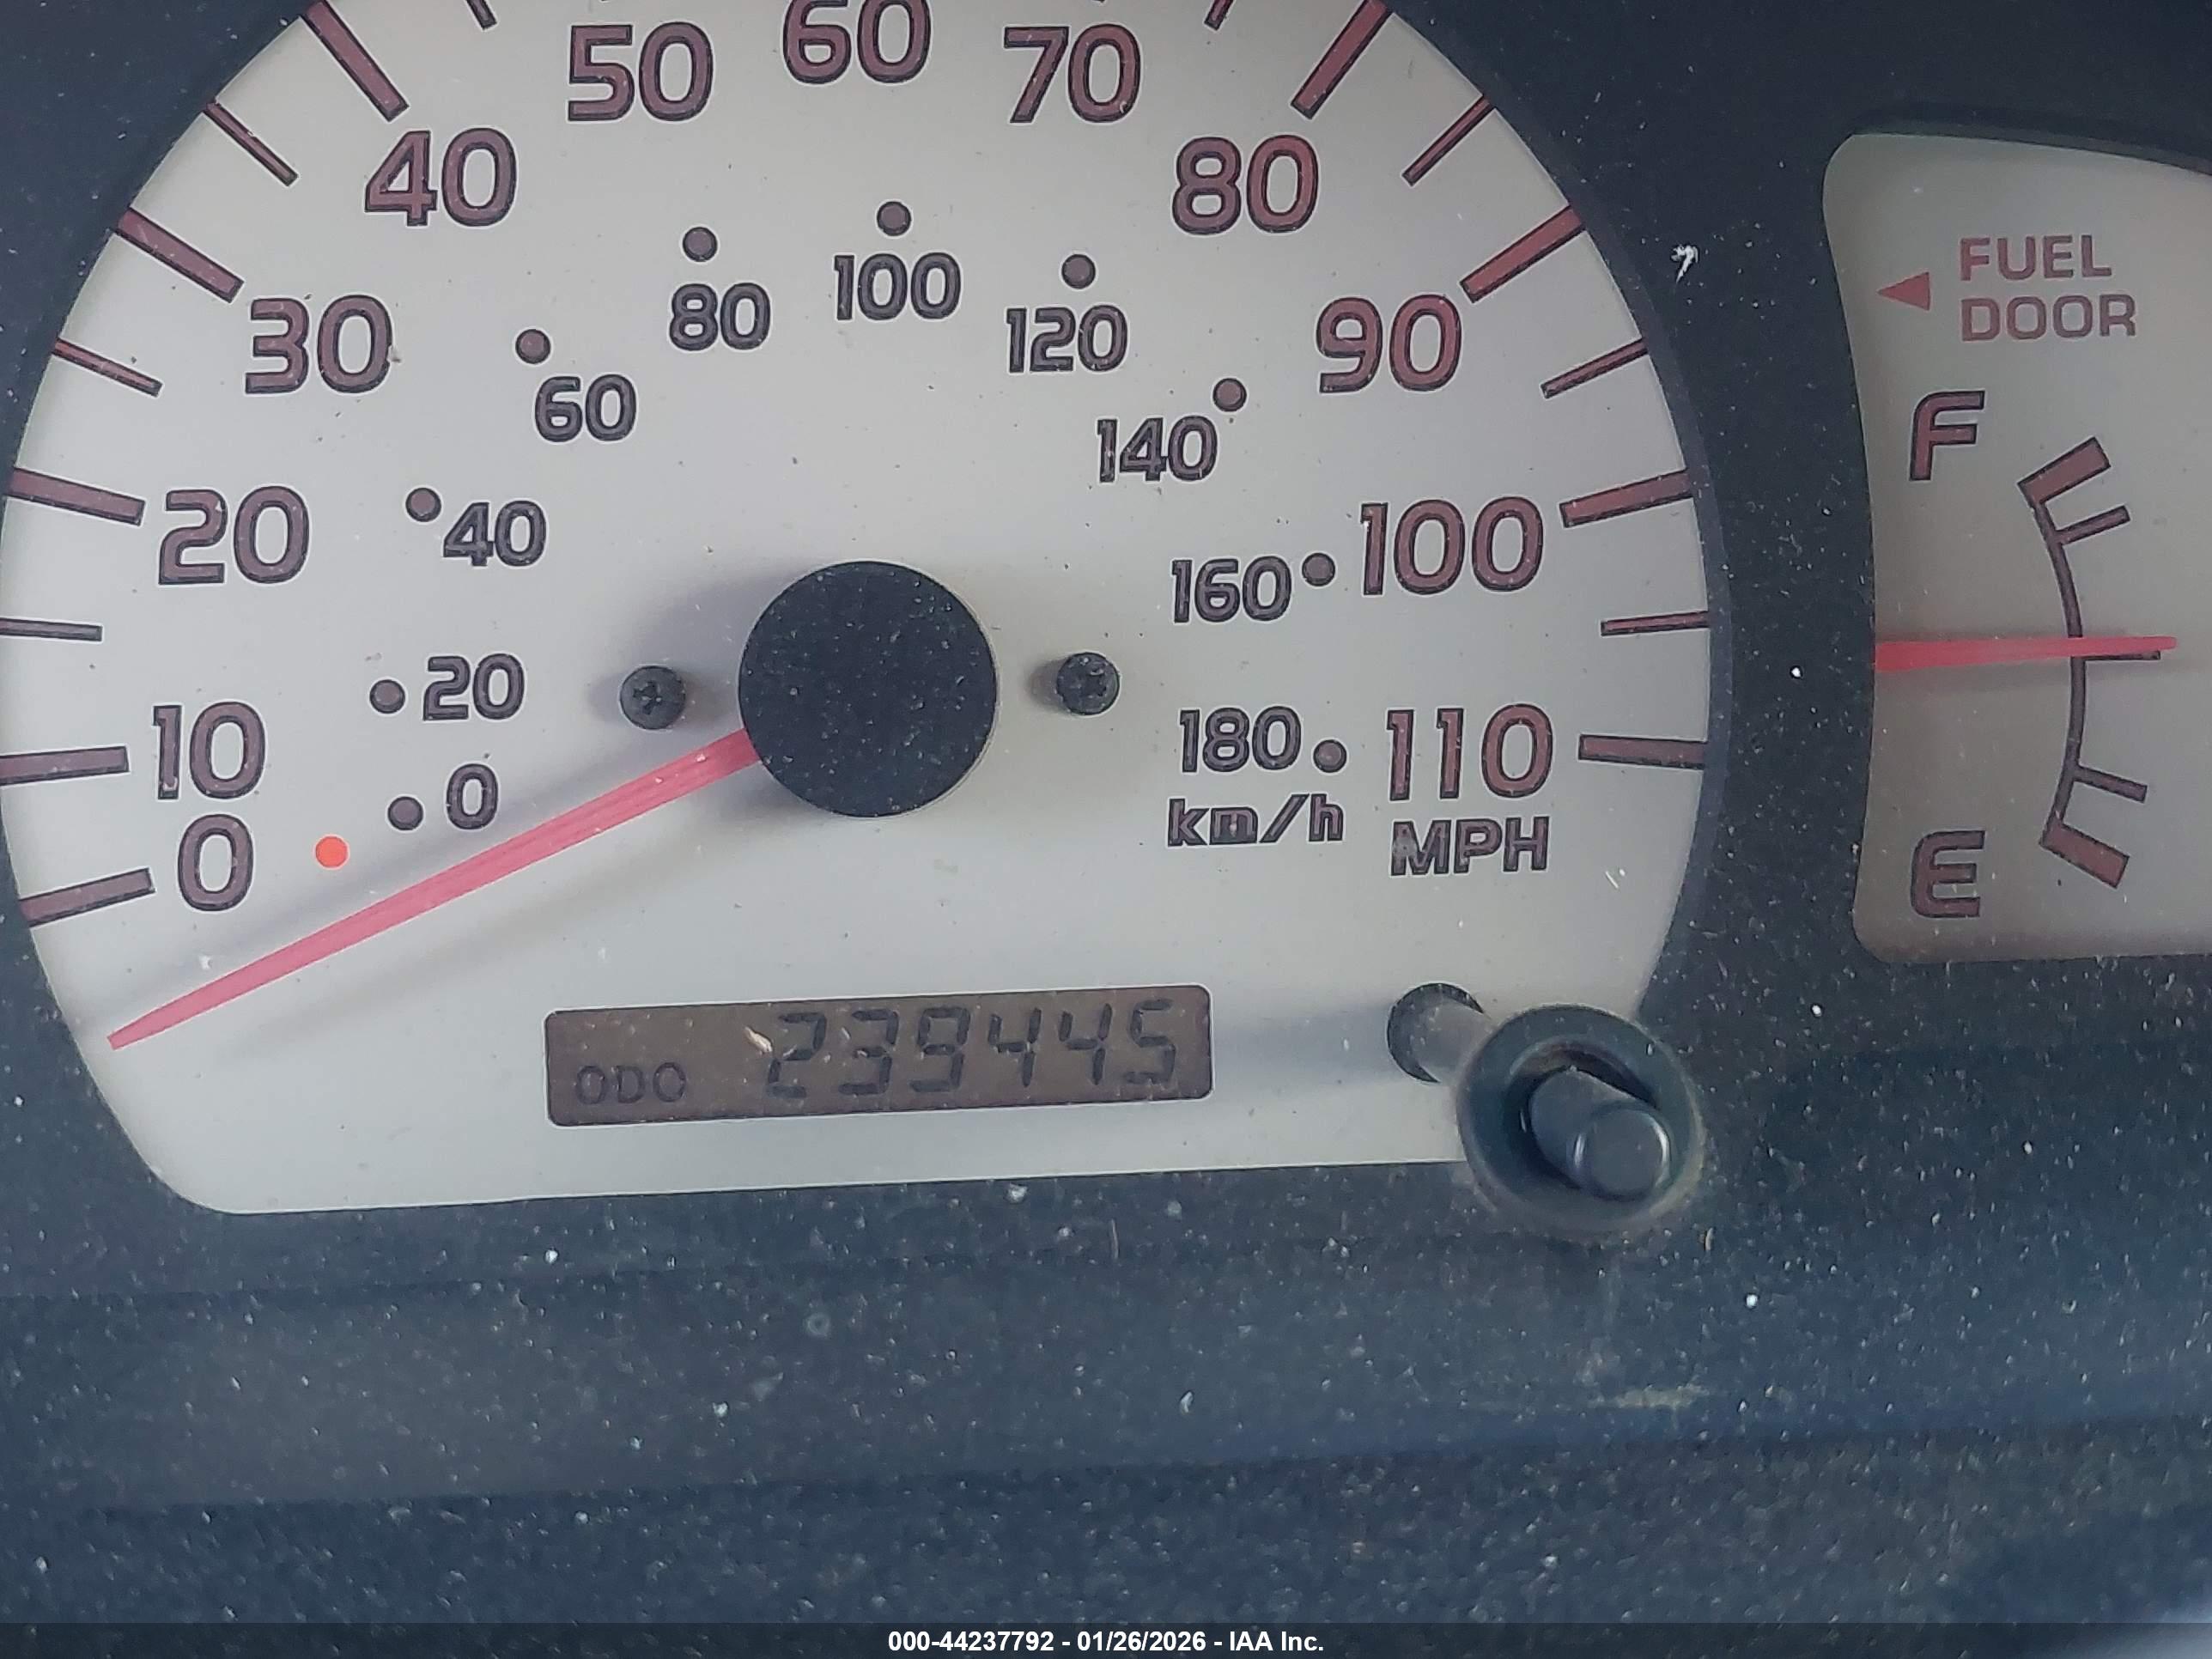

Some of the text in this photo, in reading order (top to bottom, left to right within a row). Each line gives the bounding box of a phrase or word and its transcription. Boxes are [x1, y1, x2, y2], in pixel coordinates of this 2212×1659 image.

[568, 21, 714, 122] 50
[782, 0, 932, 84] 60
[1003, 23, 1140, 124] 70
[364, 128, 518, 228] 40
[1171, 134, 1320, 236] 80
[834, 252, 962, 321] 100
[1959, 234, 2112, 282] FUEL
[245, 295, 393, 396] 30
[669, 282, 771, 351] 80
[1006, 304, 1129, 374] 120
[1315, 294, 1462, 395] 90
[1960, 294, 2137, 343] DOOR
[535, 374, 638, 442] 60
[1097, 415, 1218, 484] 140
[1908, 389, 1986, 483] F
[158, 485, 310, 586] 20
[442, 500, 548, 568] 40
[1360, 498, 1544, 596] 100
[1171, 556, 1292, 624] 160
[422, 653, 526, 722] 20
[151, 702, 266, 800] 10
[1178, 705, 1302, 774] 180
[1385, 702, 1554, 804] 110
[445, 763, 499, 830] 0
[1166, 793, 1345, 848] km/h
[178, 813, 253, 912] 0
[1390, 815, 1549, 878] MPH
[1909, 829, 1986, 920] E
[574, 998, 1177, 1108] ODO 239445
